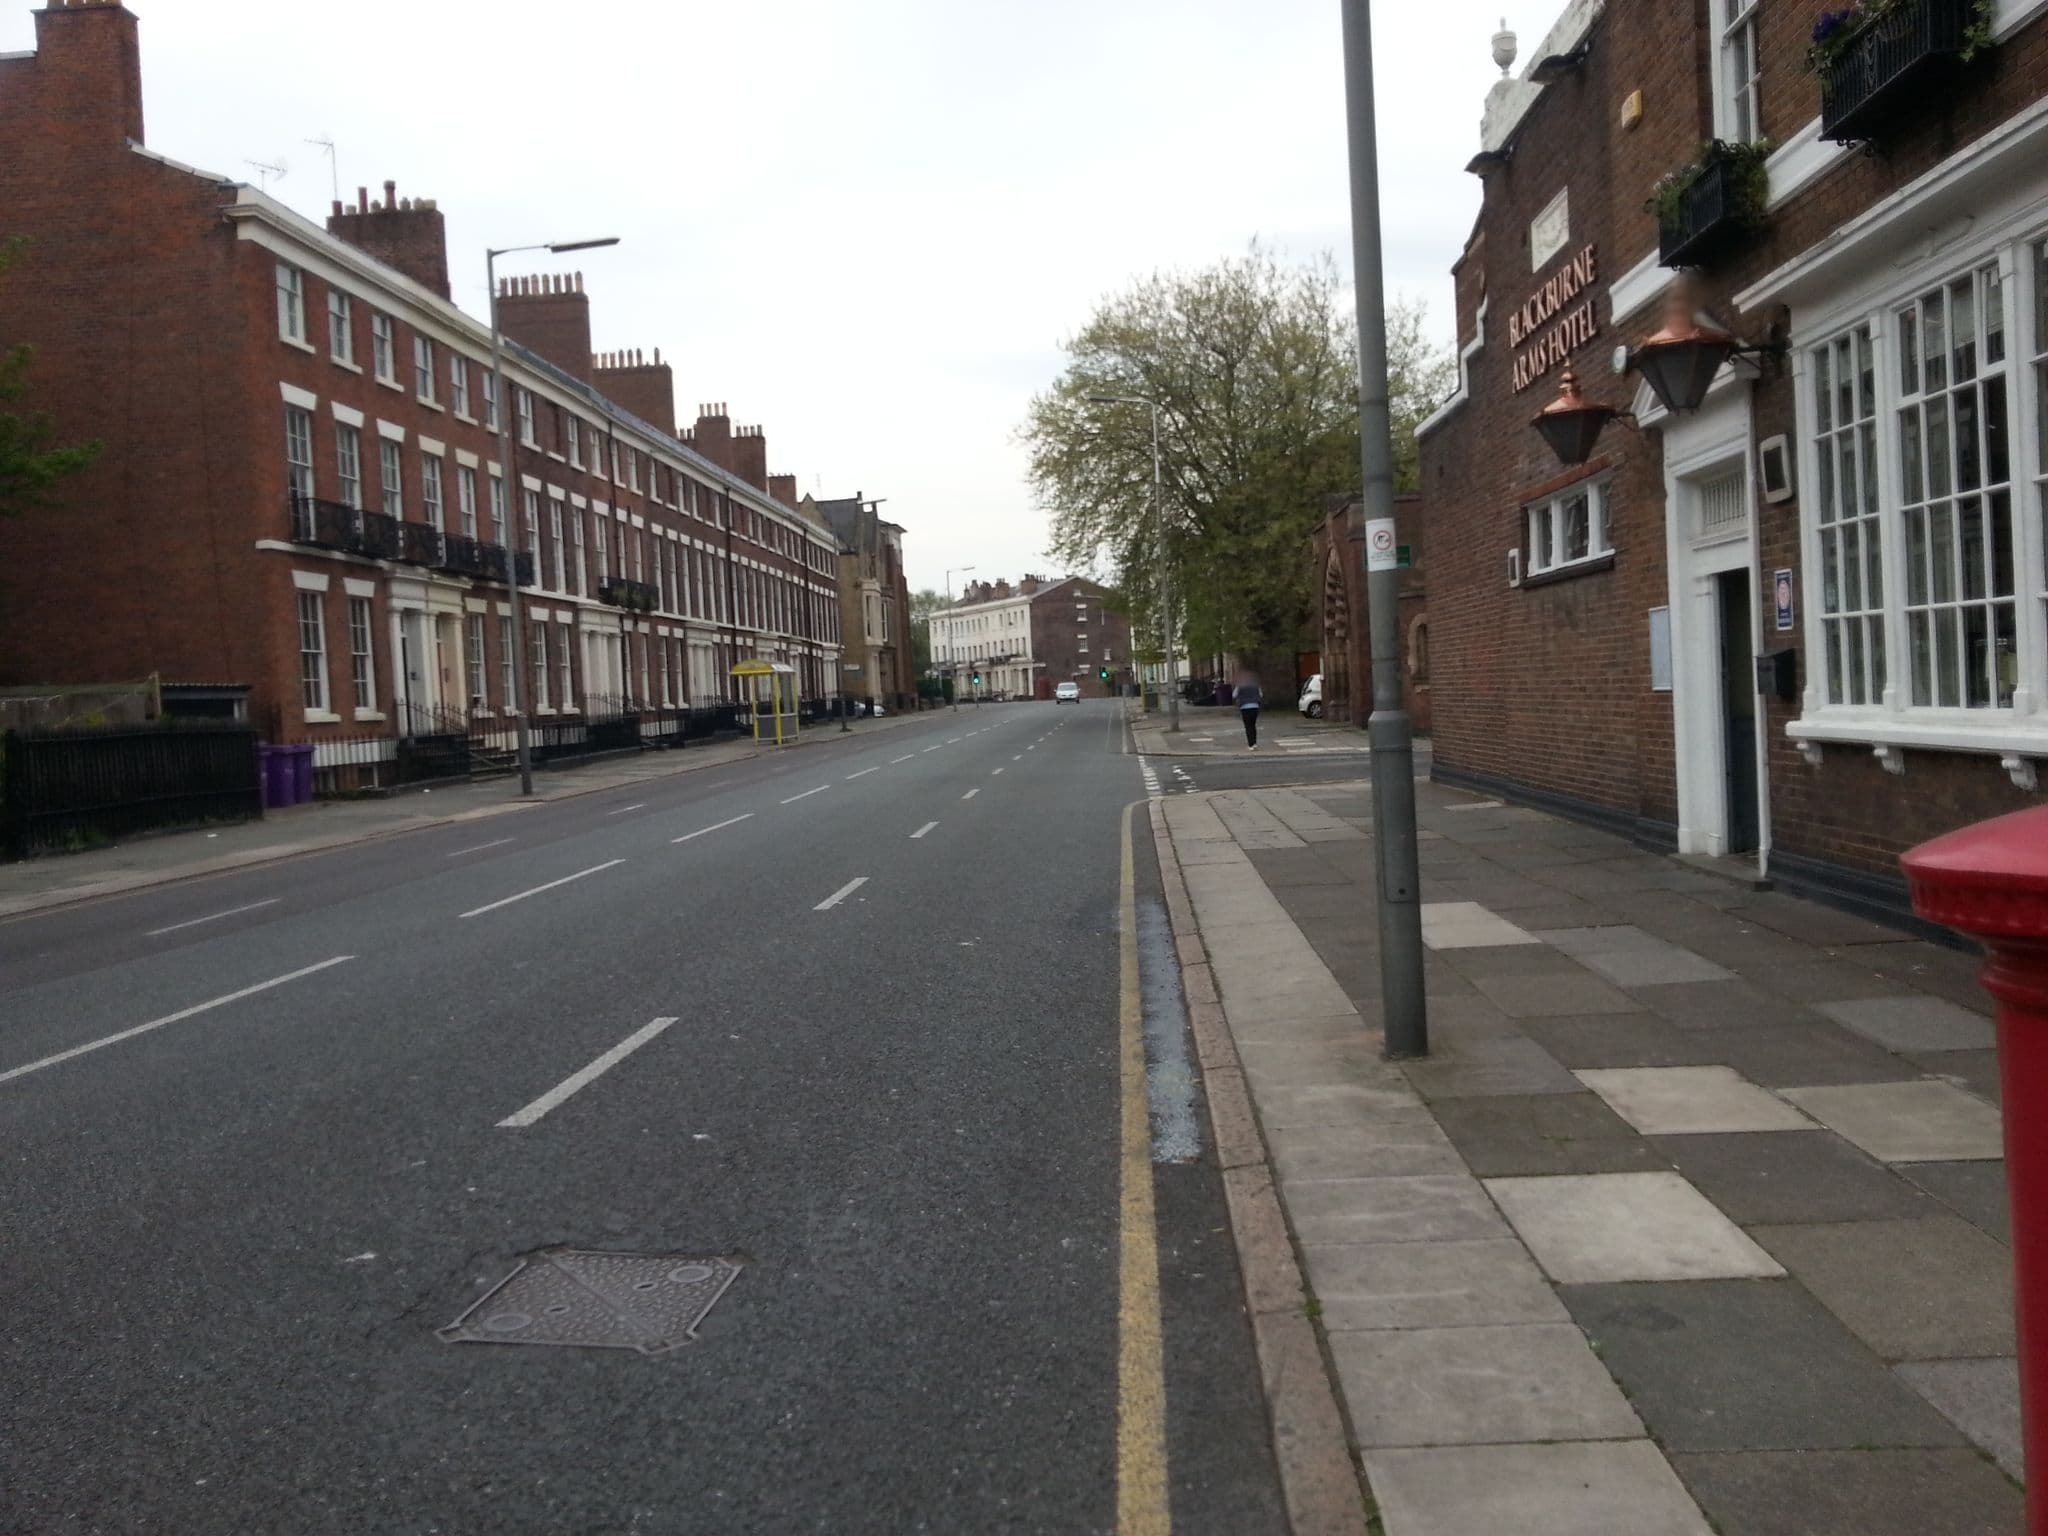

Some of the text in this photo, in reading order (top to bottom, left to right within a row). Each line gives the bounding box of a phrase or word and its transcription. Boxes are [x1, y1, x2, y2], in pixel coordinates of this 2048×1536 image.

[1509, 245, 1596, 348] BLACKBURNE
[1512, 300, 1597, 394] ARMS HOTEL
